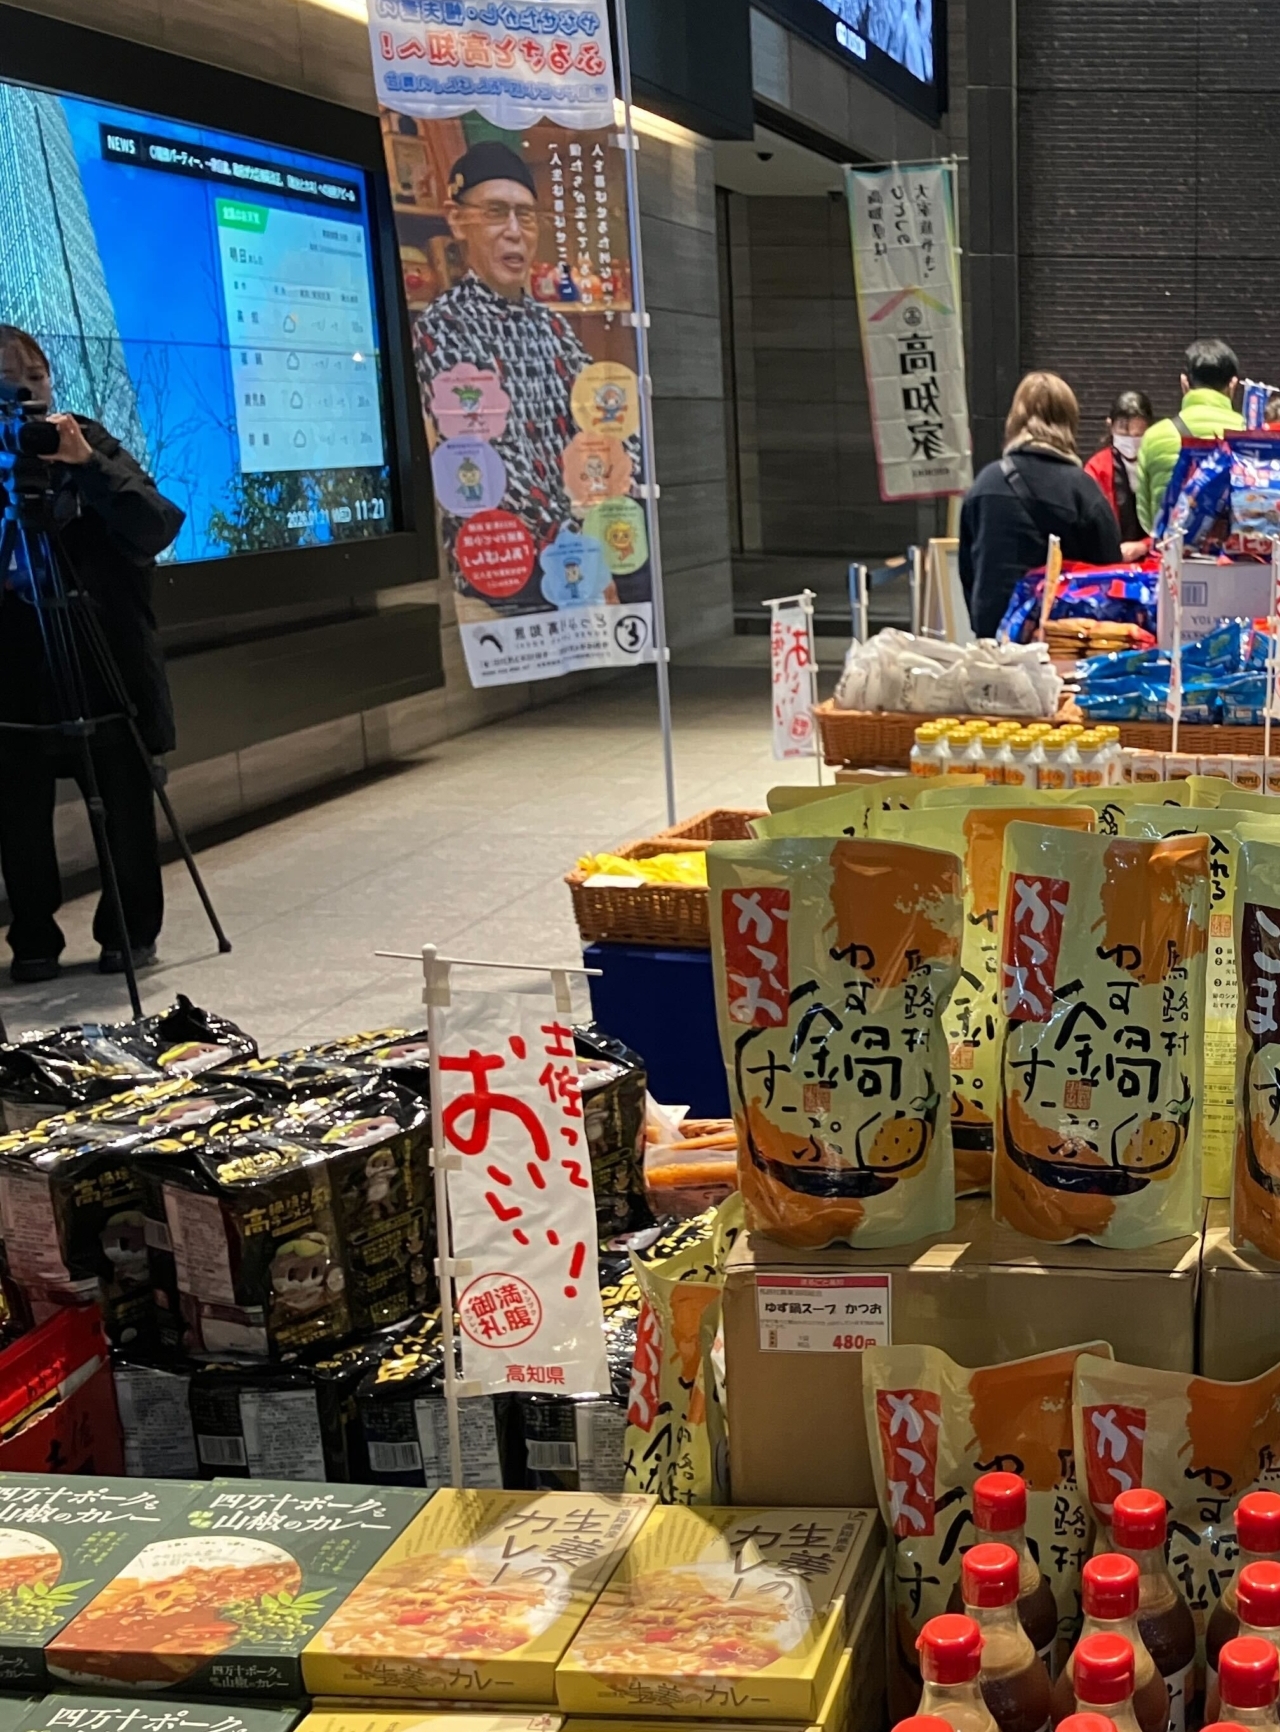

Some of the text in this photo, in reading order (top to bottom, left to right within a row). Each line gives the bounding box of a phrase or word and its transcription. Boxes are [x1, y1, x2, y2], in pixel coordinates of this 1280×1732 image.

[107, 134, 136, 155] NEWS
[729, 890, 790, 1025] かつお
[1003, 878, 1068, 1019] かつお
[900, 948, 935, 1054] 馬路村
[1160, 939, 1191, 1057] 馬路村
[765, 1302, 882, 1315] ゆず鍋スープ かつお
[833, 1335, 877, 1349] 480円
[505, 1365, 566, 1385] 高知県
[885, 1393, 943, 1531] かつお
[210, 1493, 388, 1518] 四万十ポークと
[210, 1510, 392, 1533] 山椒のカレー
[46, 1706, 250, 1732] 四万十ポーク
